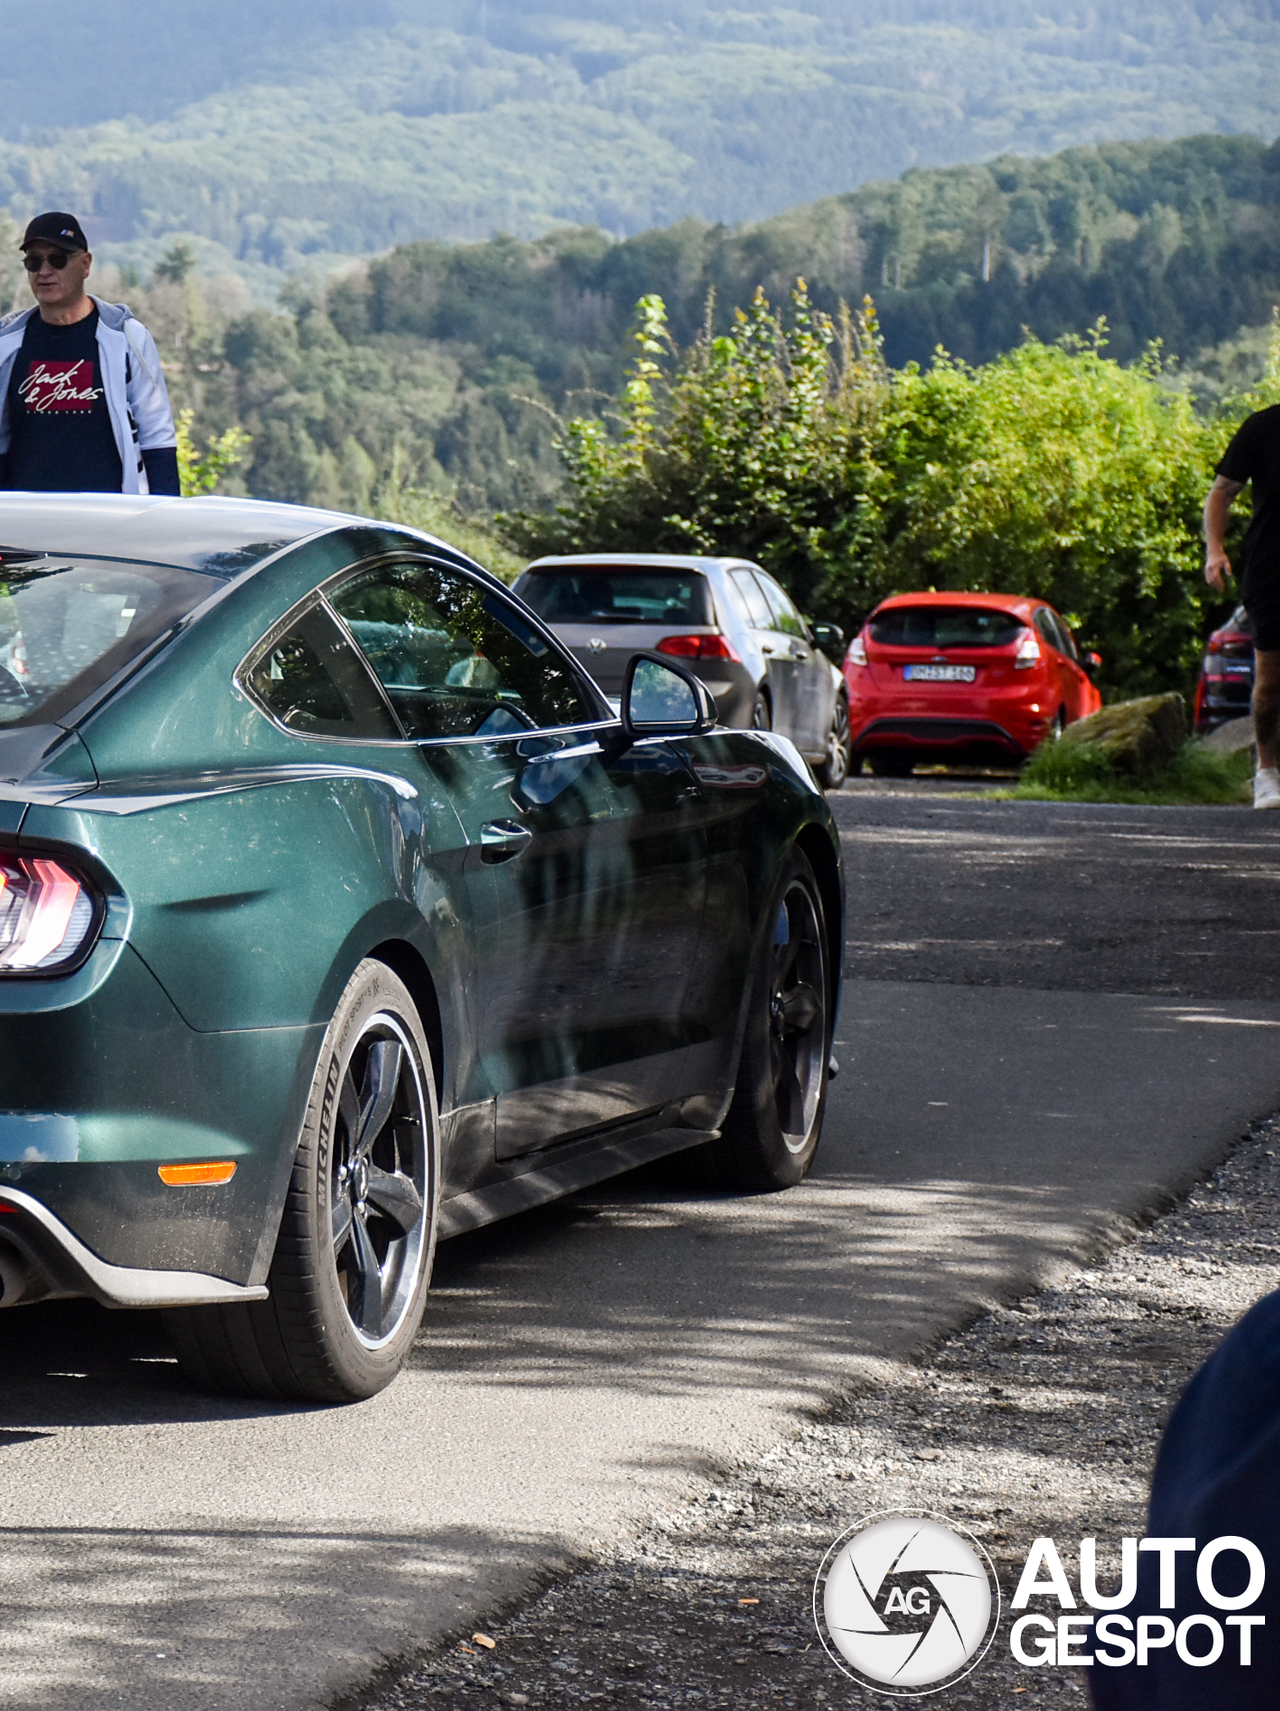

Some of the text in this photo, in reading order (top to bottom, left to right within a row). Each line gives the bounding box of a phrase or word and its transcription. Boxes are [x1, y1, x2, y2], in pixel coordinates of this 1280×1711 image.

[18, 359, 85, 394] Jack
[24, 383, 104, 411] & Jones
[317, 1062, 339, 1208] MICHELIN
